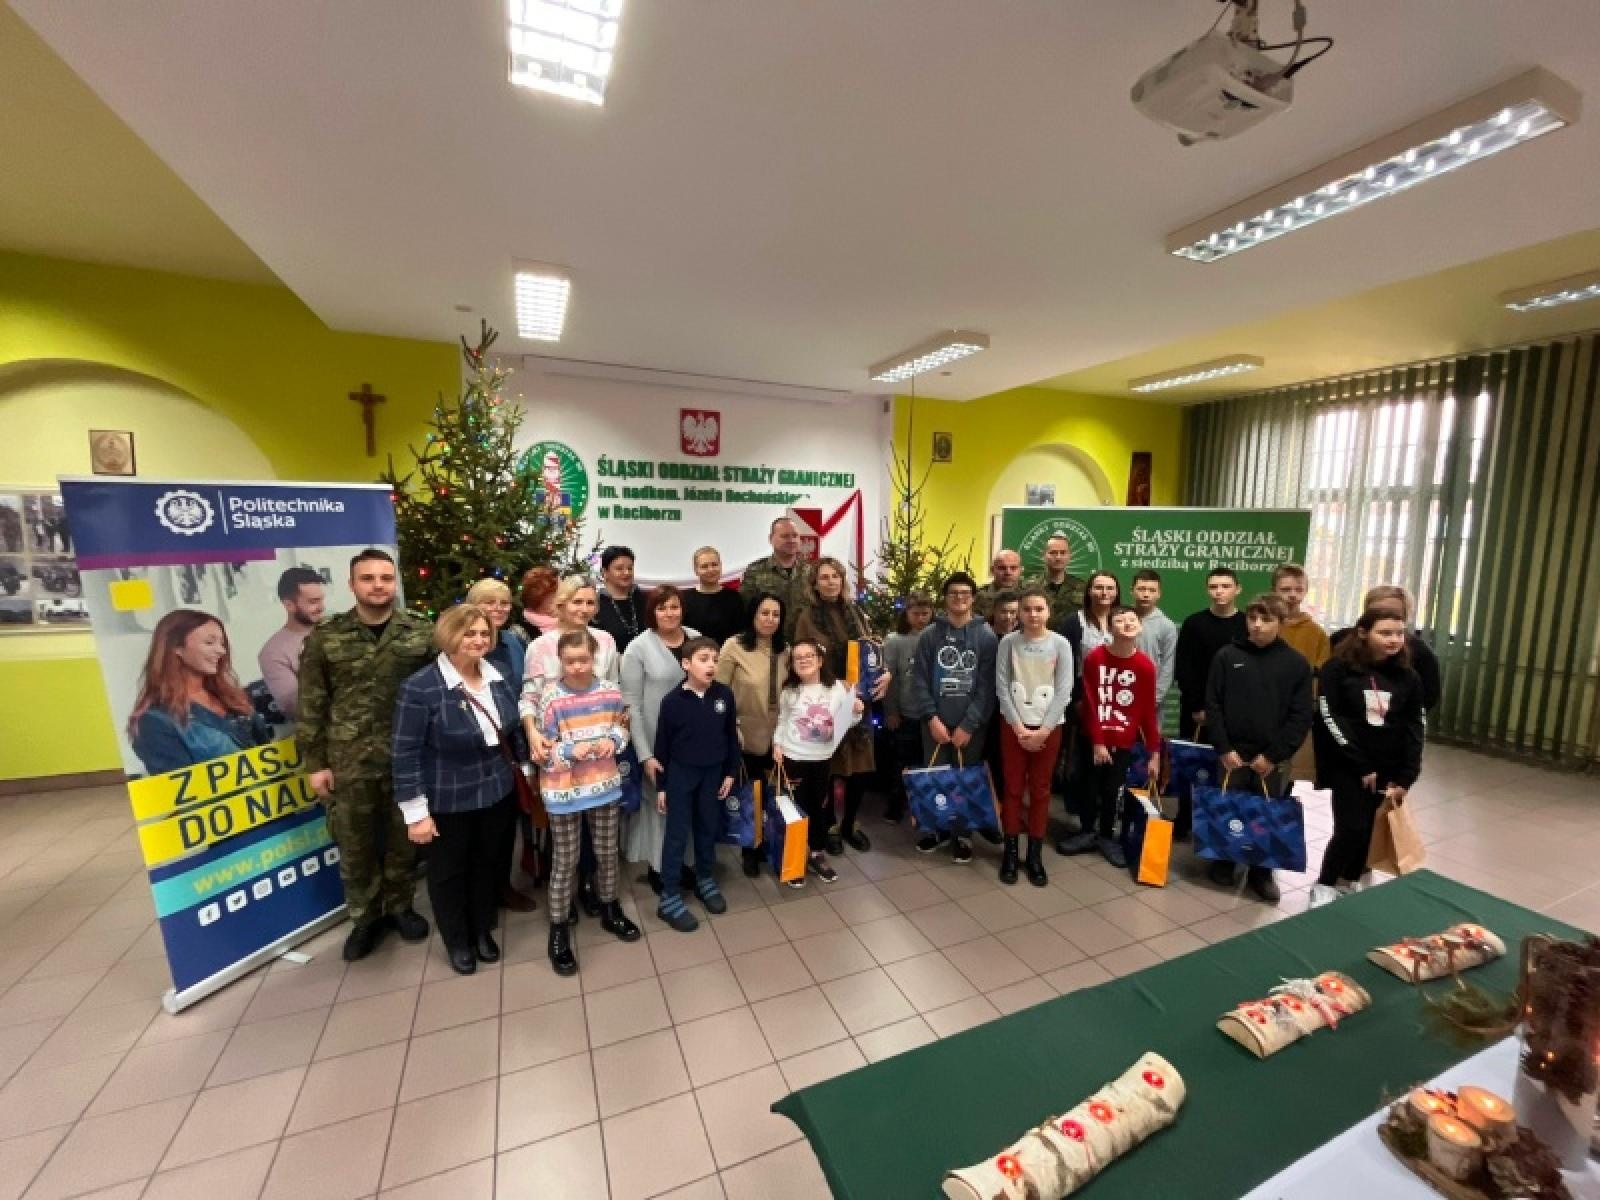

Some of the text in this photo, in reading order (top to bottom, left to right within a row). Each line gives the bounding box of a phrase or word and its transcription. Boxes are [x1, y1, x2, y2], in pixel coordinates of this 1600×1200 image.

[597, 454, 654, 480] ŚLĄSKI
[723, 464, 777, 484] STRAŻY
[778, 469, 855, 488] GRANICZNEJ
[229, 496, 345, 512] Politechnika
[597, 505, 610, 519] w
[232, 511, 297, 530] Śląska
[1131, 526, 1278, 546] ŚLĄSKI ODDZIAŁ
[1113, 541, 1295, 564] STRAŻY GRANICZNEJ
[1119, 557, 1281, 573] z siedzibą w Raciborz
[168, 747, 303, 806] Z PASJ
[179, 777, 321, 848] DO NAU
[193, 826, 331, 893] www.polsl.p
